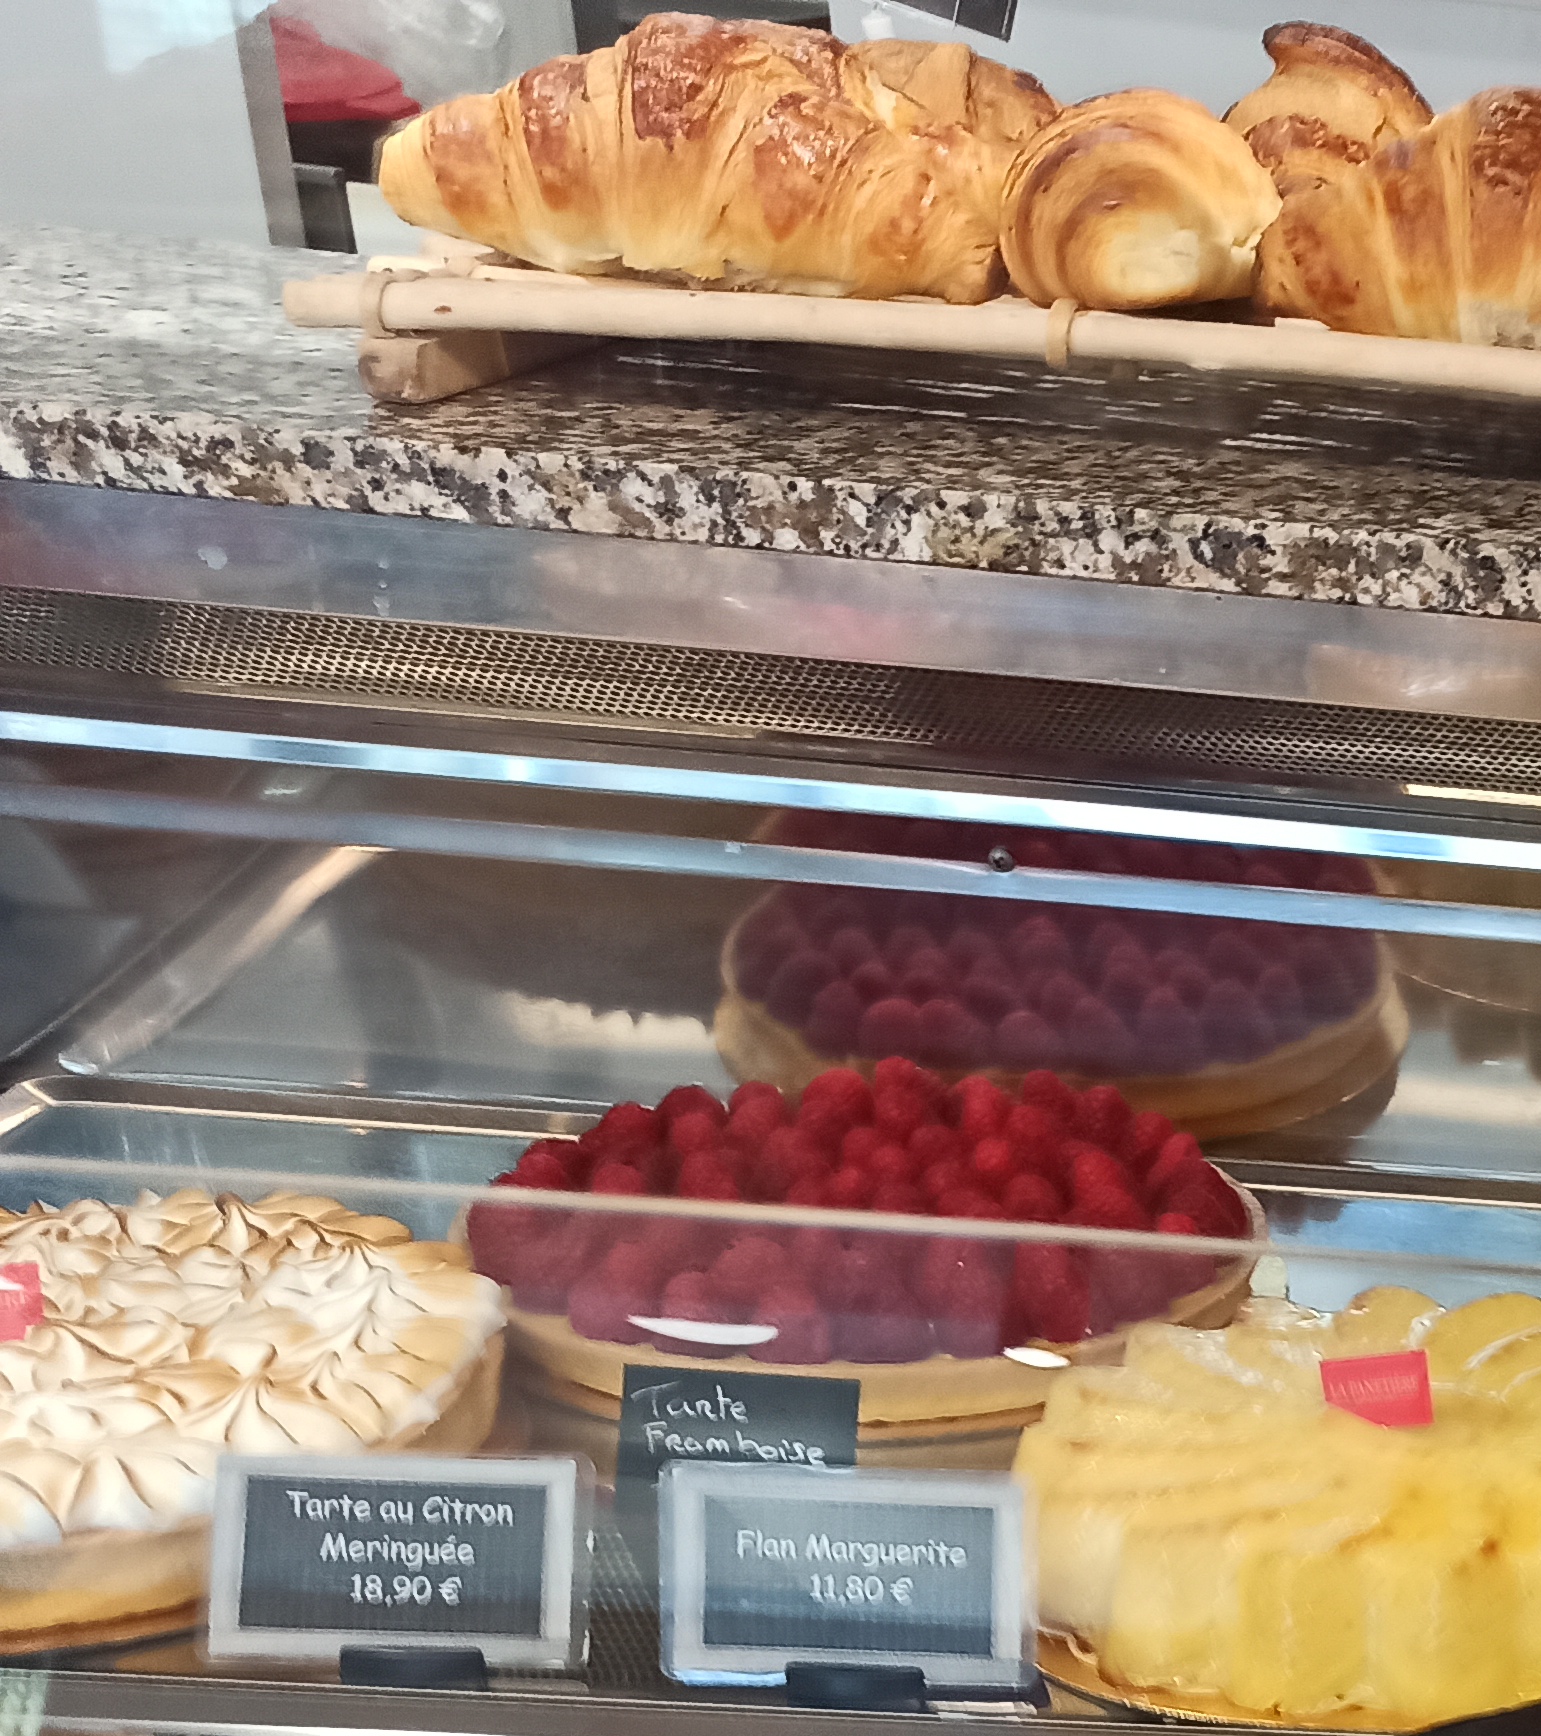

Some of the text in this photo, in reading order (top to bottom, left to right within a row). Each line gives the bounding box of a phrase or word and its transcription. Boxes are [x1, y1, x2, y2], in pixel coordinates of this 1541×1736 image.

[630, 1380, 748, 1424] Tarte
[286, 1489, 515, 1527] Tarte au Citron
[319, 1531, 476, 1572] Meringuée
[735, 1528, 969, 1569] Flan Marguerite
[350, 1573, 463, 1608] 18,90 €
[809, 1573, 915, 1608] 11,80 €
